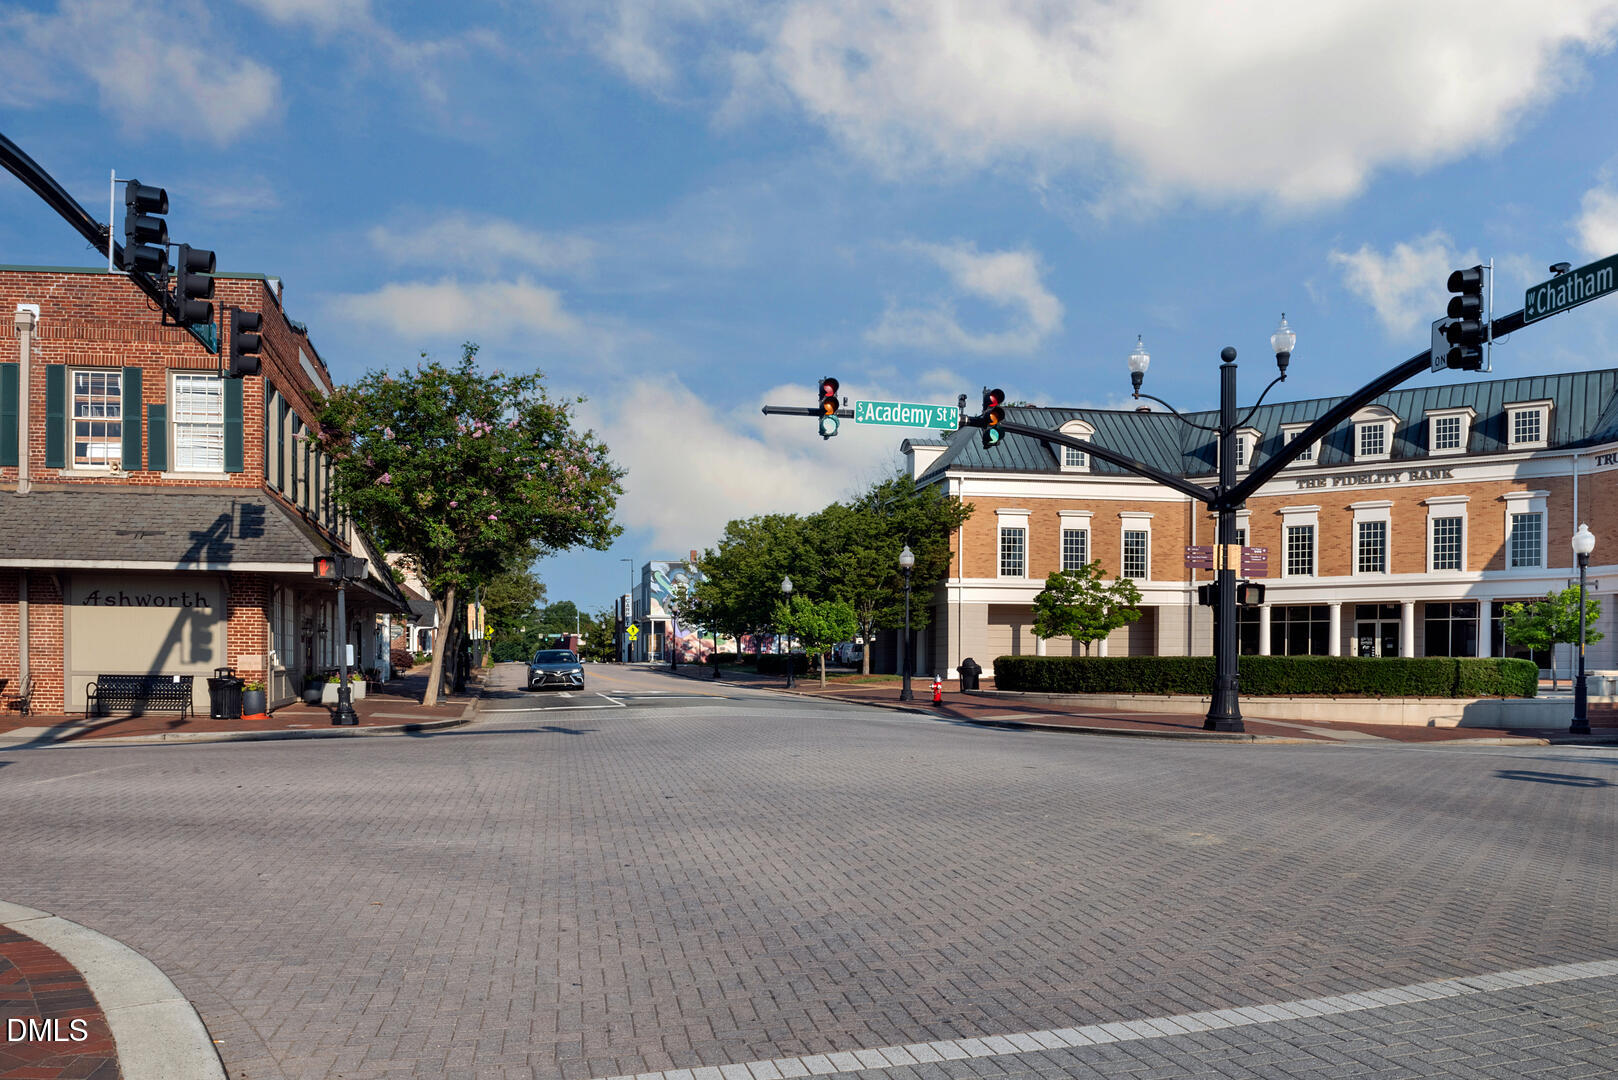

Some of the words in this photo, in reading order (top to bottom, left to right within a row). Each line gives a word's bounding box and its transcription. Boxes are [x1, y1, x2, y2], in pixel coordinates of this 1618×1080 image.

[1537, 266, 1613, 313] Chatham
[1435, 354, 1446, 367] ON
[864, 403, 933, 428] Academy
[936, 407, 947, 422] St
[1296, 478, 1327, 489] THE
[1332, 471, 1401, 487] FIDELITY
[1408, 468, 1454, 481] BANK
[82, 590, 211, 607] Ashworth
